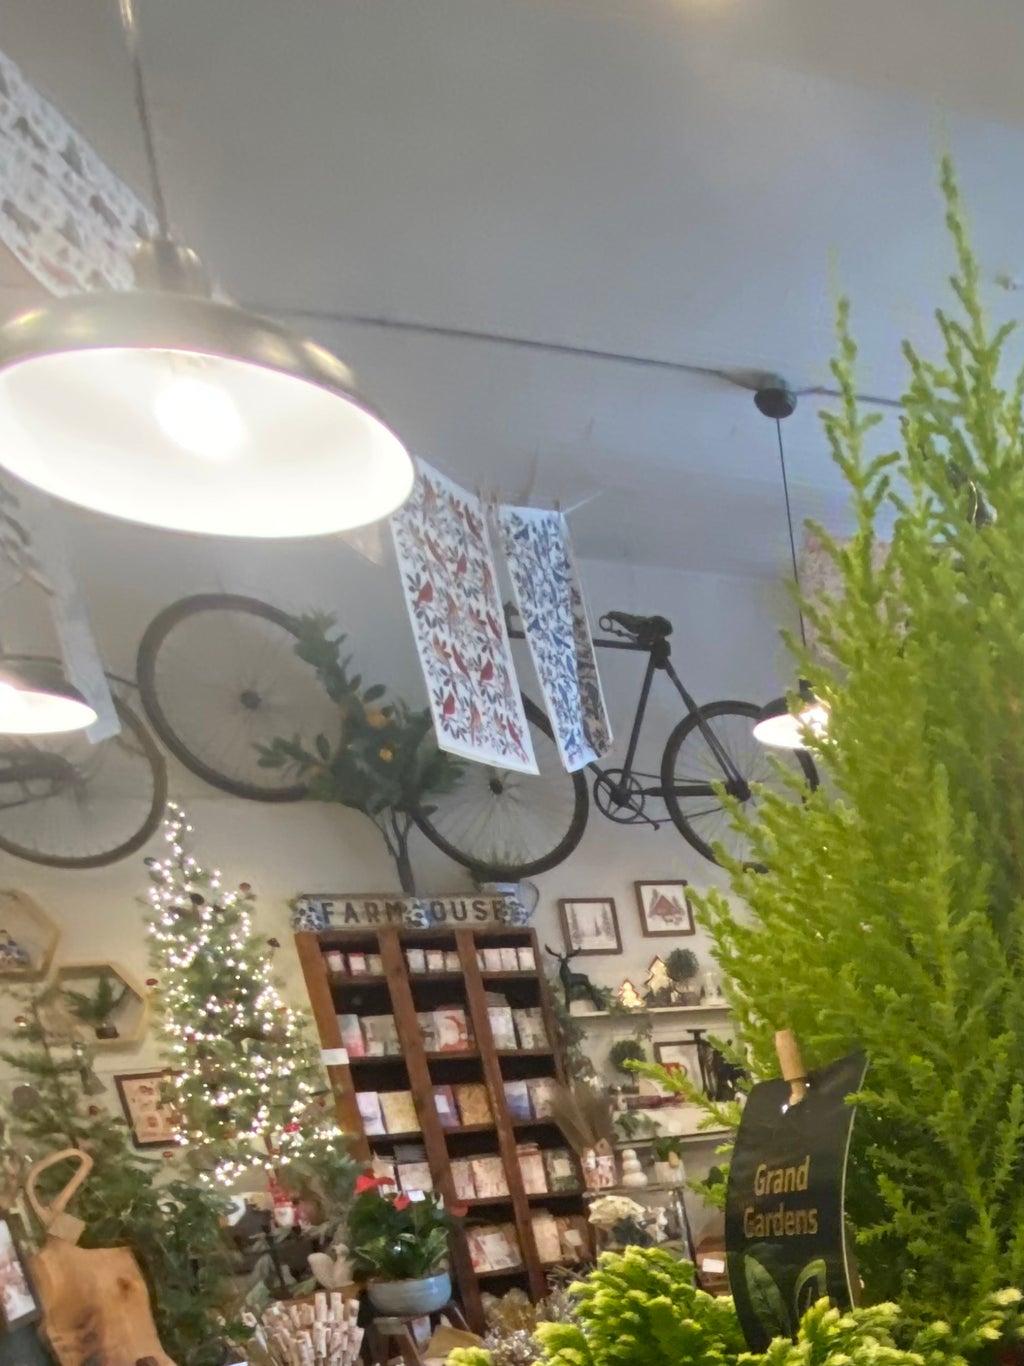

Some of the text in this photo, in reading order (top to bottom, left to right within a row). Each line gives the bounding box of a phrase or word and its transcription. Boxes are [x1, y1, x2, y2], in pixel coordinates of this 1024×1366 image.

[322, 901, 508, 924] FARMOUSE
[754, 1154, 811, 1196] Grand
[743, 1203, 819, 1238] Gardens
